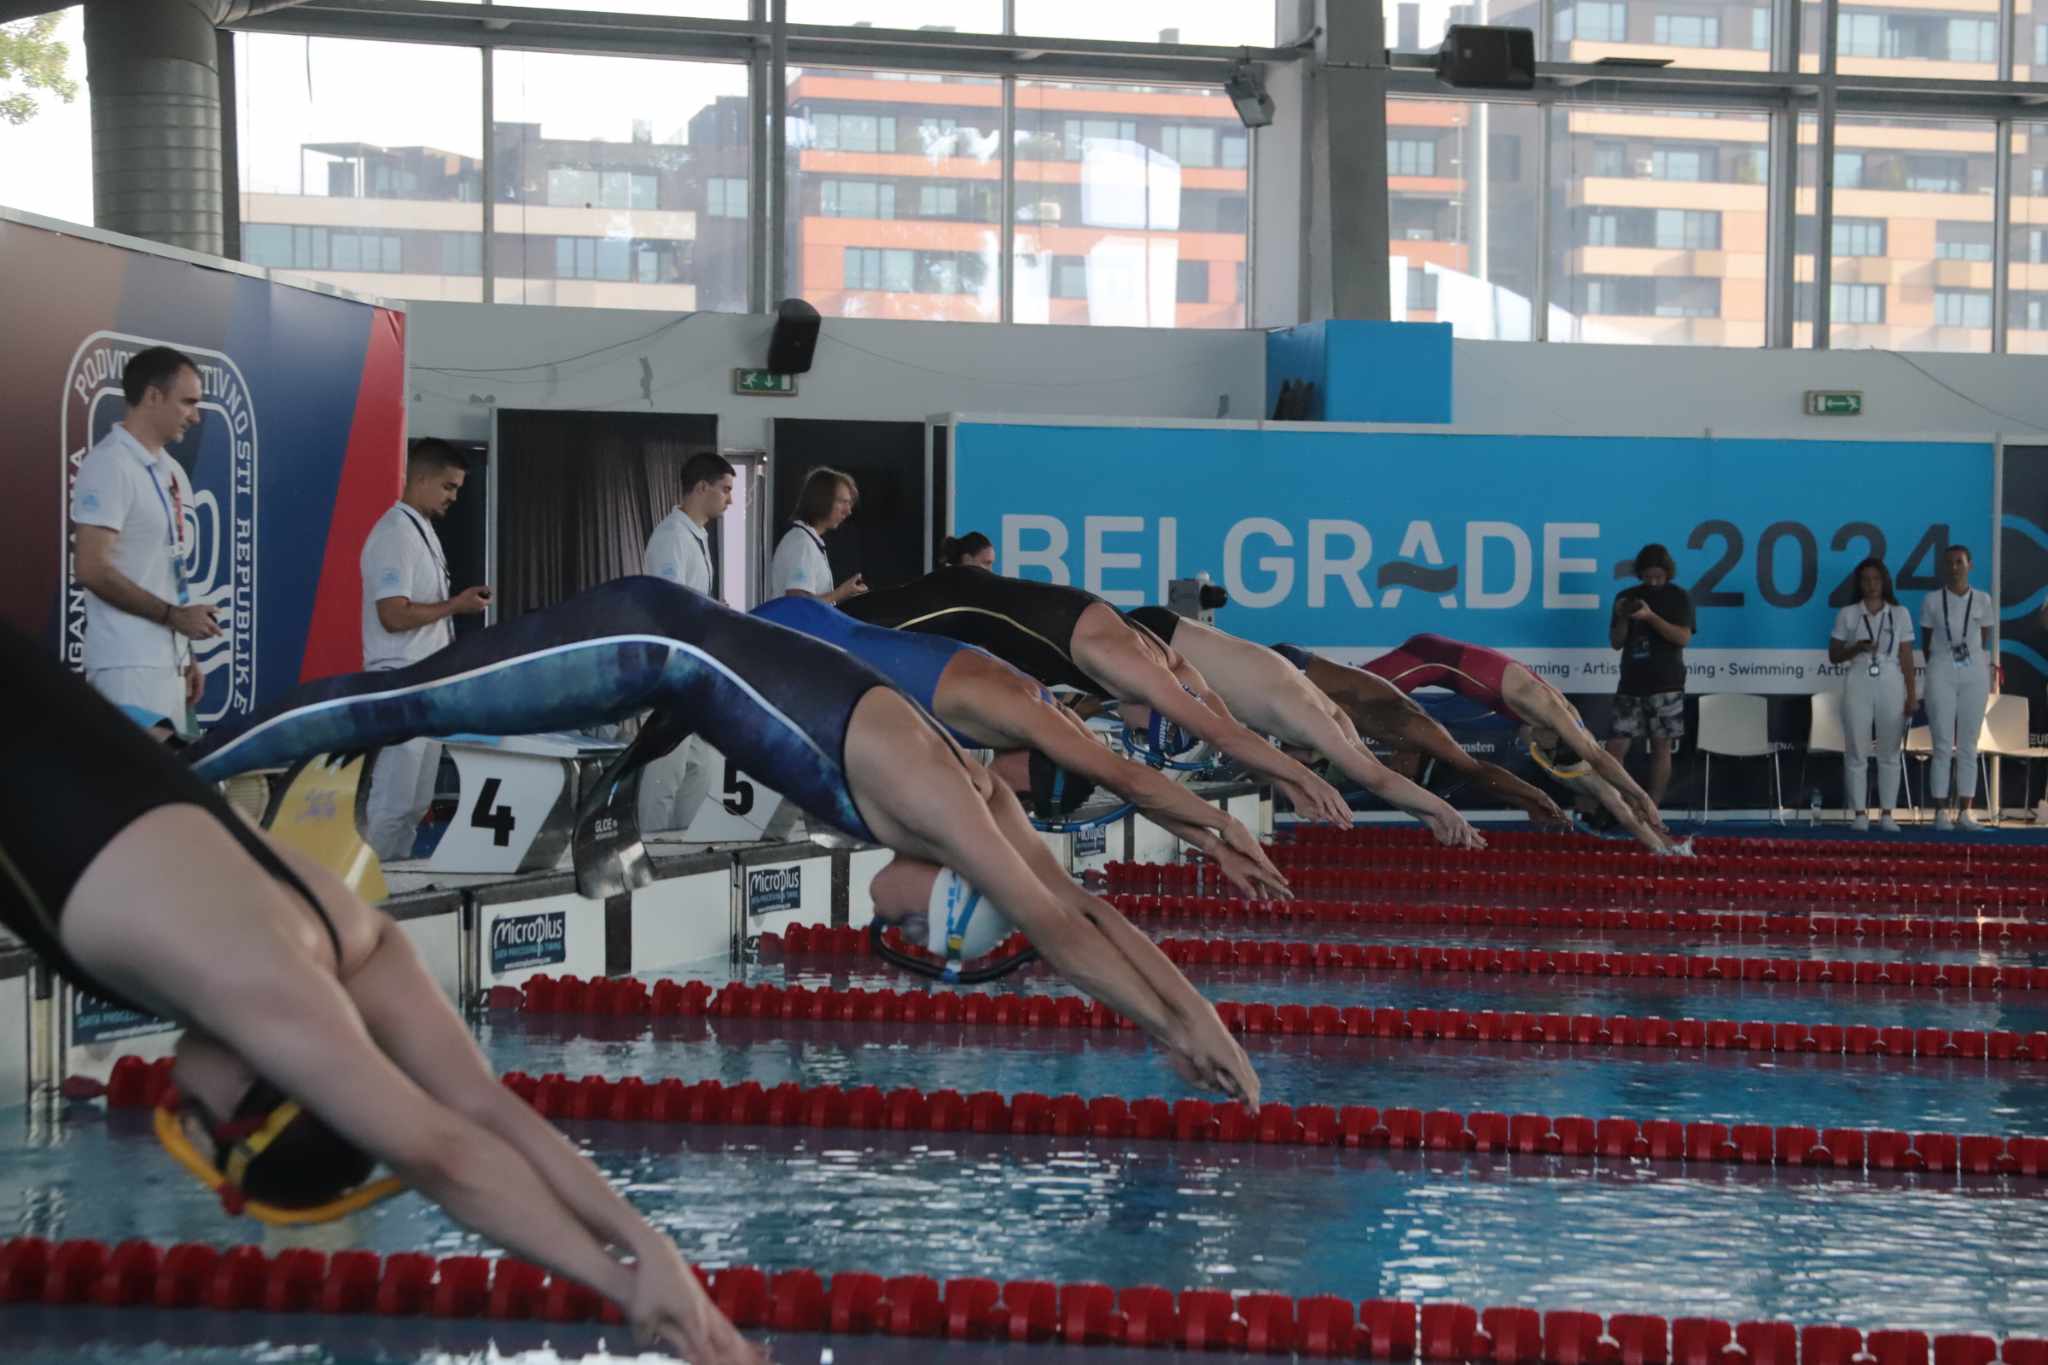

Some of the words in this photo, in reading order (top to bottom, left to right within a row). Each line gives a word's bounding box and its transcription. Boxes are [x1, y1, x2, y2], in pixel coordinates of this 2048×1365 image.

[1001, 513, 1601, 611] BELGRADE
[1685, 518, 1952, 610] 2024
[234, 517, 252, 715] REPUBLIKE
[1728, 661, 1804, 679] Swimming
[470, 777, 516, 847] 4
[722, 758, 754, 816] 5
